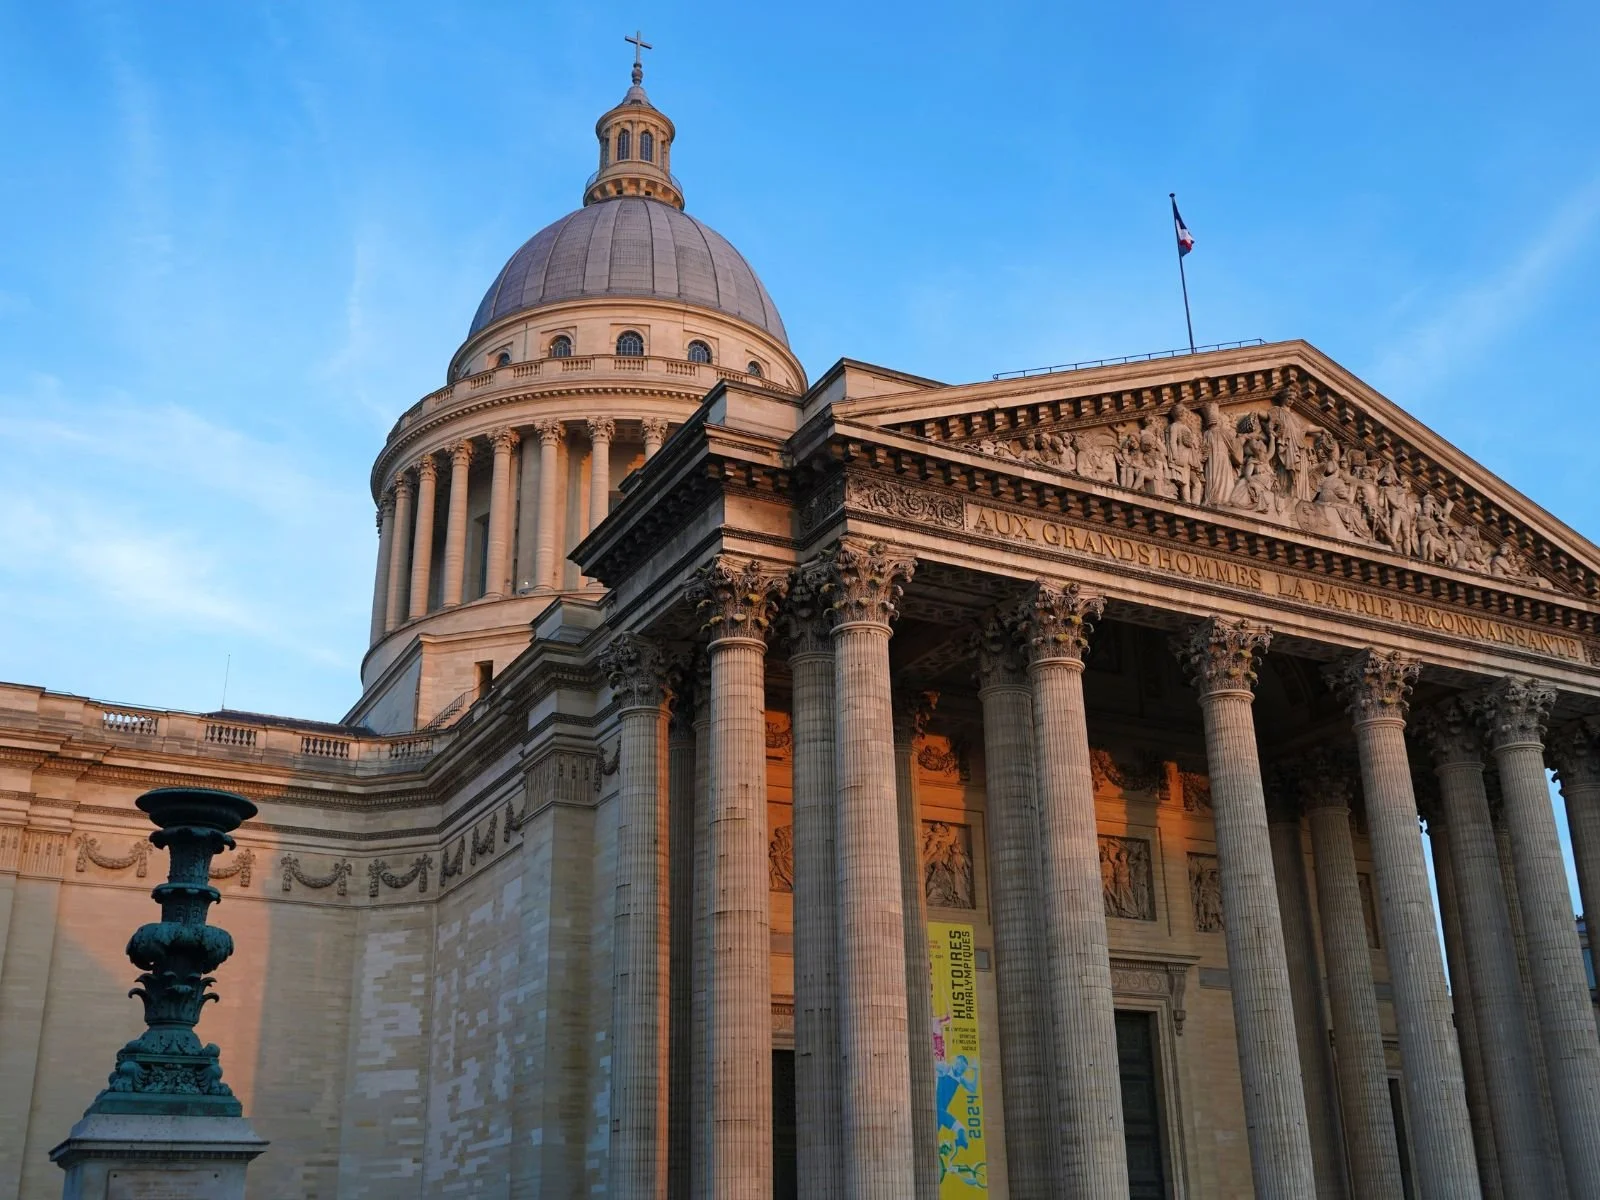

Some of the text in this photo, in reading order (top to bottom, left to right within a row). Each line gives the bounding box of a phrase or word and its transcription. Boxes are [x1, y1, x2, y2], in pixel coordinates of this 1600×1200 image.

[974, 507, 1580, 659] AUX GRANDS HOMMES LA PATRIE RECONNAISSANTE
[949, 930, 965, 1019] HISTOIRES
[962, 931, 974, 1020] PARALYMPIQUES
[967, 1095, 981, 1139] 2024
